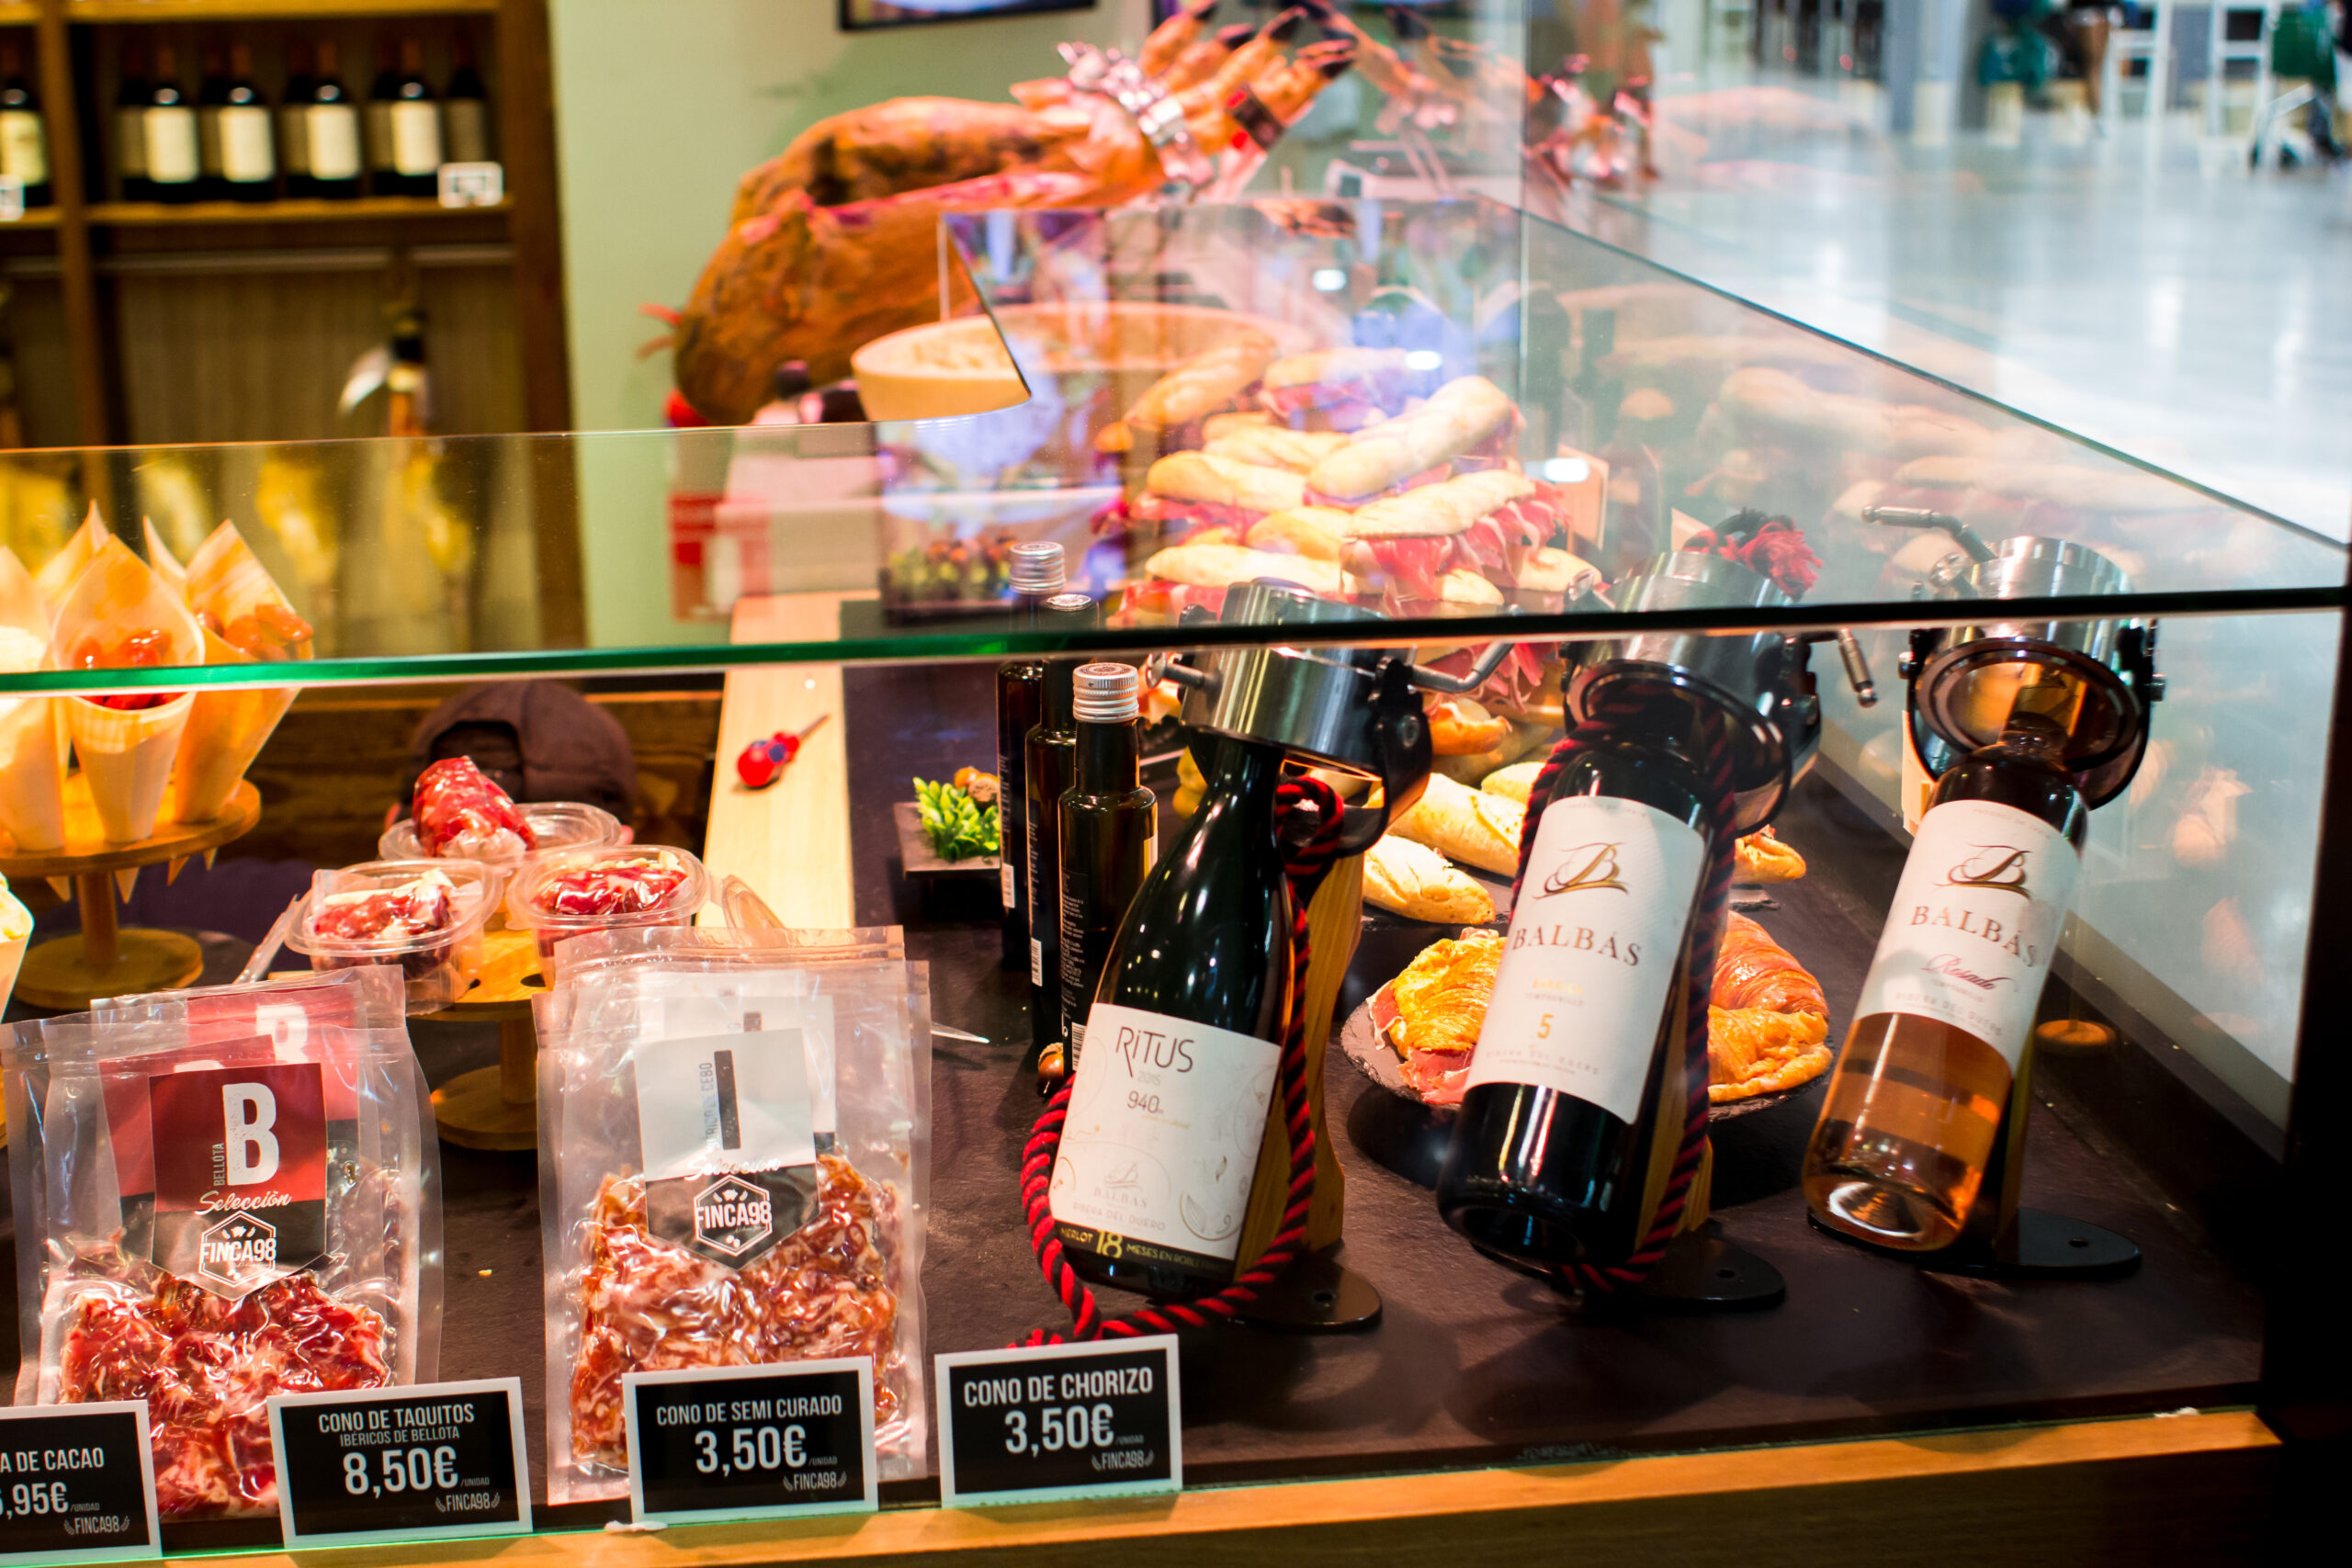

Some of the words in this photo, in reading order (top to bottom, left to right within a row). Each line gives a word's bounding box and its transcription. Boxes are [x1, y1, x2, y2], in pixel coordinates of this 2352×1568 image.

[1511, 924, 1643, 966] BALBÁS
[1911, 906, 2038, 967] BALBÁS
[1537, 1013, 1555, 1040] 5
[1127, 1089, 1160, 1114] 940
[222, 1082, 280, 1187] B
[212, 1143, 226, 1187] BELLOTA
[195, 1190, 292, 1216] Selección
[695, 1201, 773, 1229] FINCA98
[199, 1237, 277, 1264] FINCA98
[1096, 1229, 1124, 1259] 18
[964, 1378, 1023, 1407] CONO
[1027, 1375, 1056, 1403] DE
[1061, 1370, 1154, 1400] CHORIZO
[318, 1411, 364, 1433] CONO
[368, 1409, 391, 1430] DE
[393, 1403, 475, 1427] TAQUITOS
[656, 1404, 702, 1426] CONO
[706, 1402, 728, 1423] DE
[730, 1399, 772, 1421] SEMI
[775, 1394, 842, 1418] CURADO
[340, 1430, 391, 1447] IBÉRICOS
[394, 1429, 410, 1442] DE
[413, 1426, 460, 1441] BELLOTA
[1004, 1403, 1114, 1458] 3,50€
[16, 1450, 40, 1472] DE
[44, 1447, 105, 1471] CACAO
[695, 1424, 808, 1477] 3,50€
[1102, 1450, 1145, 1470] FINCA98
[343, 1445, 459, 1499] 8,50€
[460, 1477, 491, 1487] /UNIDAD
[793, 1472, 838, 1491] FINCA98
[446, 1493, 491, 1512] FINCA98
[74, 1516, 120, 1535] FINCA98
